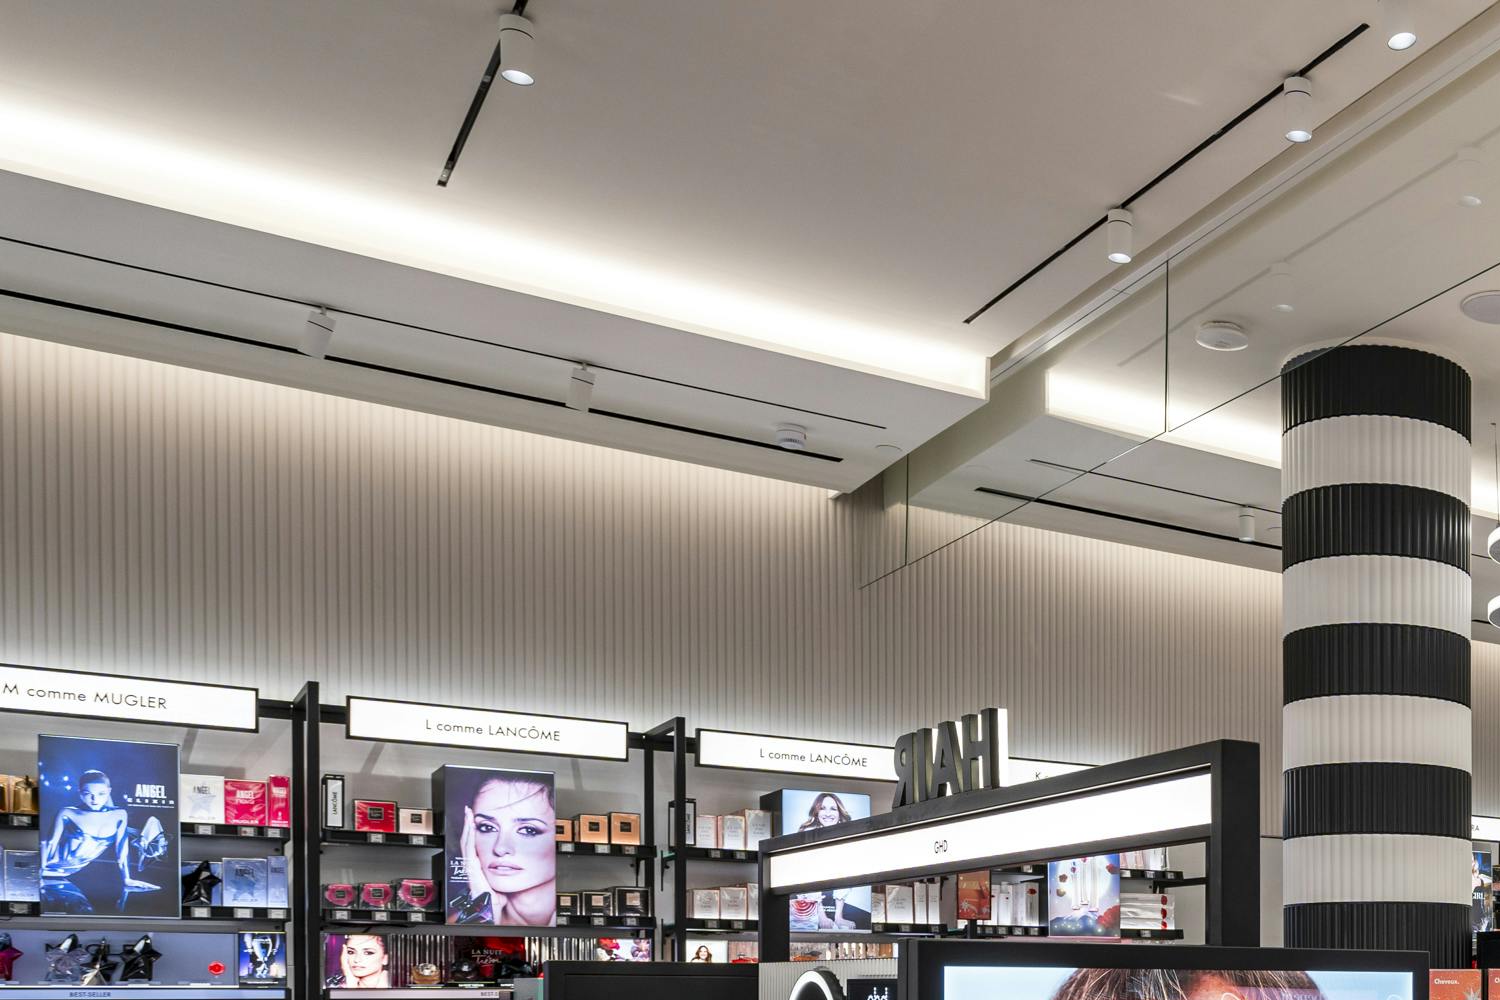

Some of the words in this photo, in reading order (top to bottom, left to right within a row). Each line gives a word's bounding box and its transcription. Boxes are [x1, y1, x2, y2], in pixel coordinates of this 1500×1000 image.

[3, 683, 19, 695] M
[27, 687, 87, 702] comme
[94, 692, 168, 710] MUGLER
[425, 719, 432, 731] L
[436, 721, 484, 735] comme
[488, 724, 561, 742] LANCÔME
[759, 748, 765, 758] L
[768, 751, 806, 762] comme
[809, 753, 868, 768] LANCÔME
[135, 783, 167, 799] ANGEL
[934, 839, 948, 854] GHD
[1434, 977, 1460, 986] Cheveux.
